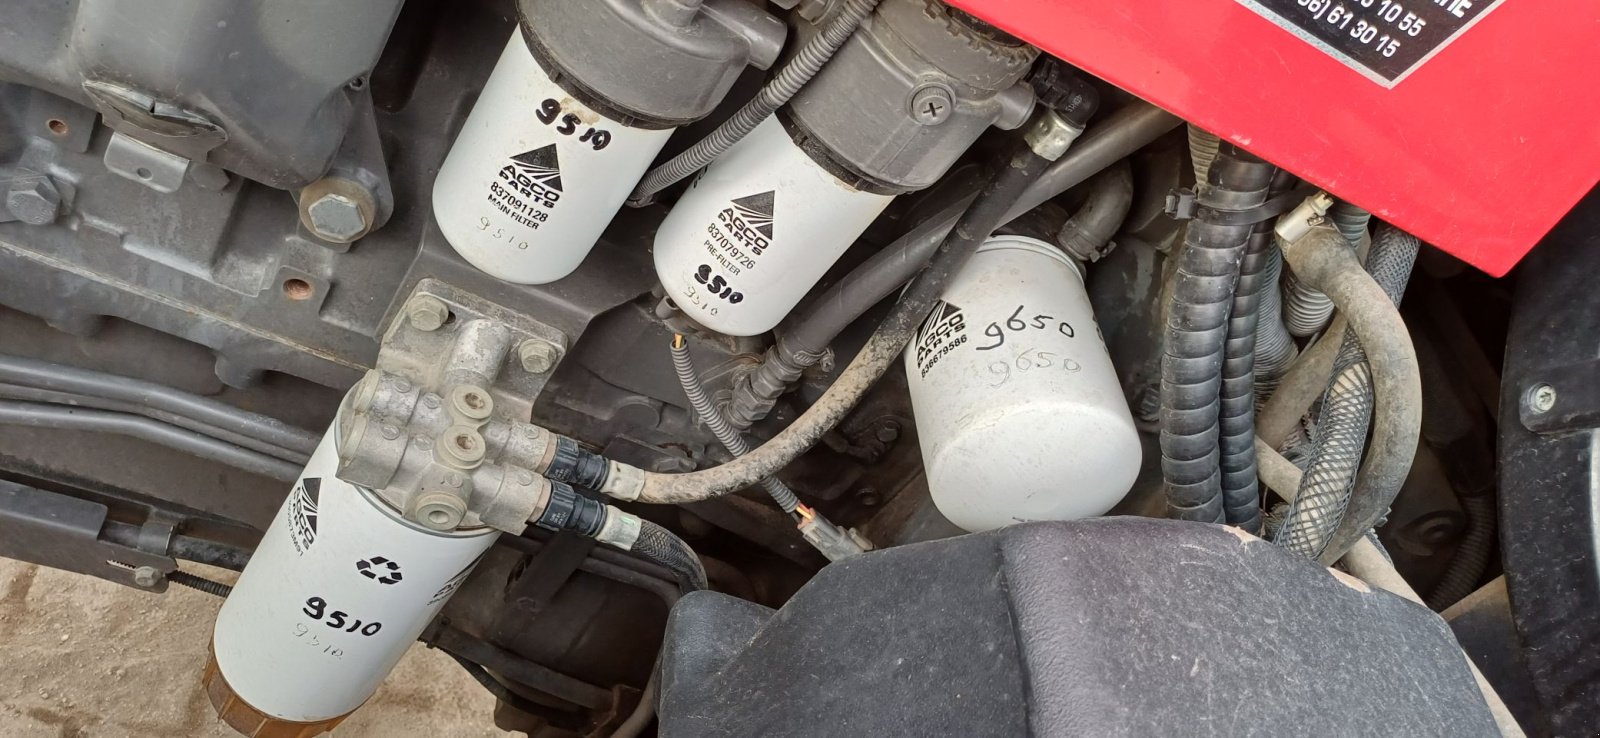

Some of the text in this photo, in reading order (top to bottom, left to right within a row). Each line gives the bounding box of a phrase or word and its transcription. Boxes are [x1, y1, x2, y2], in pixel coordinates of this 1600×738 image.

[1327, 6, 1354, 30] 61
[1350, 20, 1378, 44] 30
[1375, 35, 1401, 58] 15
[1377, 0, 1427, 37] 10 55
[490, 181, 549, 222] 837091128
[499, 169, 555, 209] PARTS
[503, 164, 560, 202] AGCO
[487, 194, 540, 230] MAIN FILTER
[722, 207, 769, 251] AGCO
[707, 222, 756, 270] 837079726
[717, 212, 763, 256] PARTS
[703, 239, 741, 276] PRE-FILTER
[917, 313, 964, 361] AGCO
[917, 322, 966, 370] PARTS
[976, 304, 1075, 351] 9650
[303, 596, 382, 637] 9510
